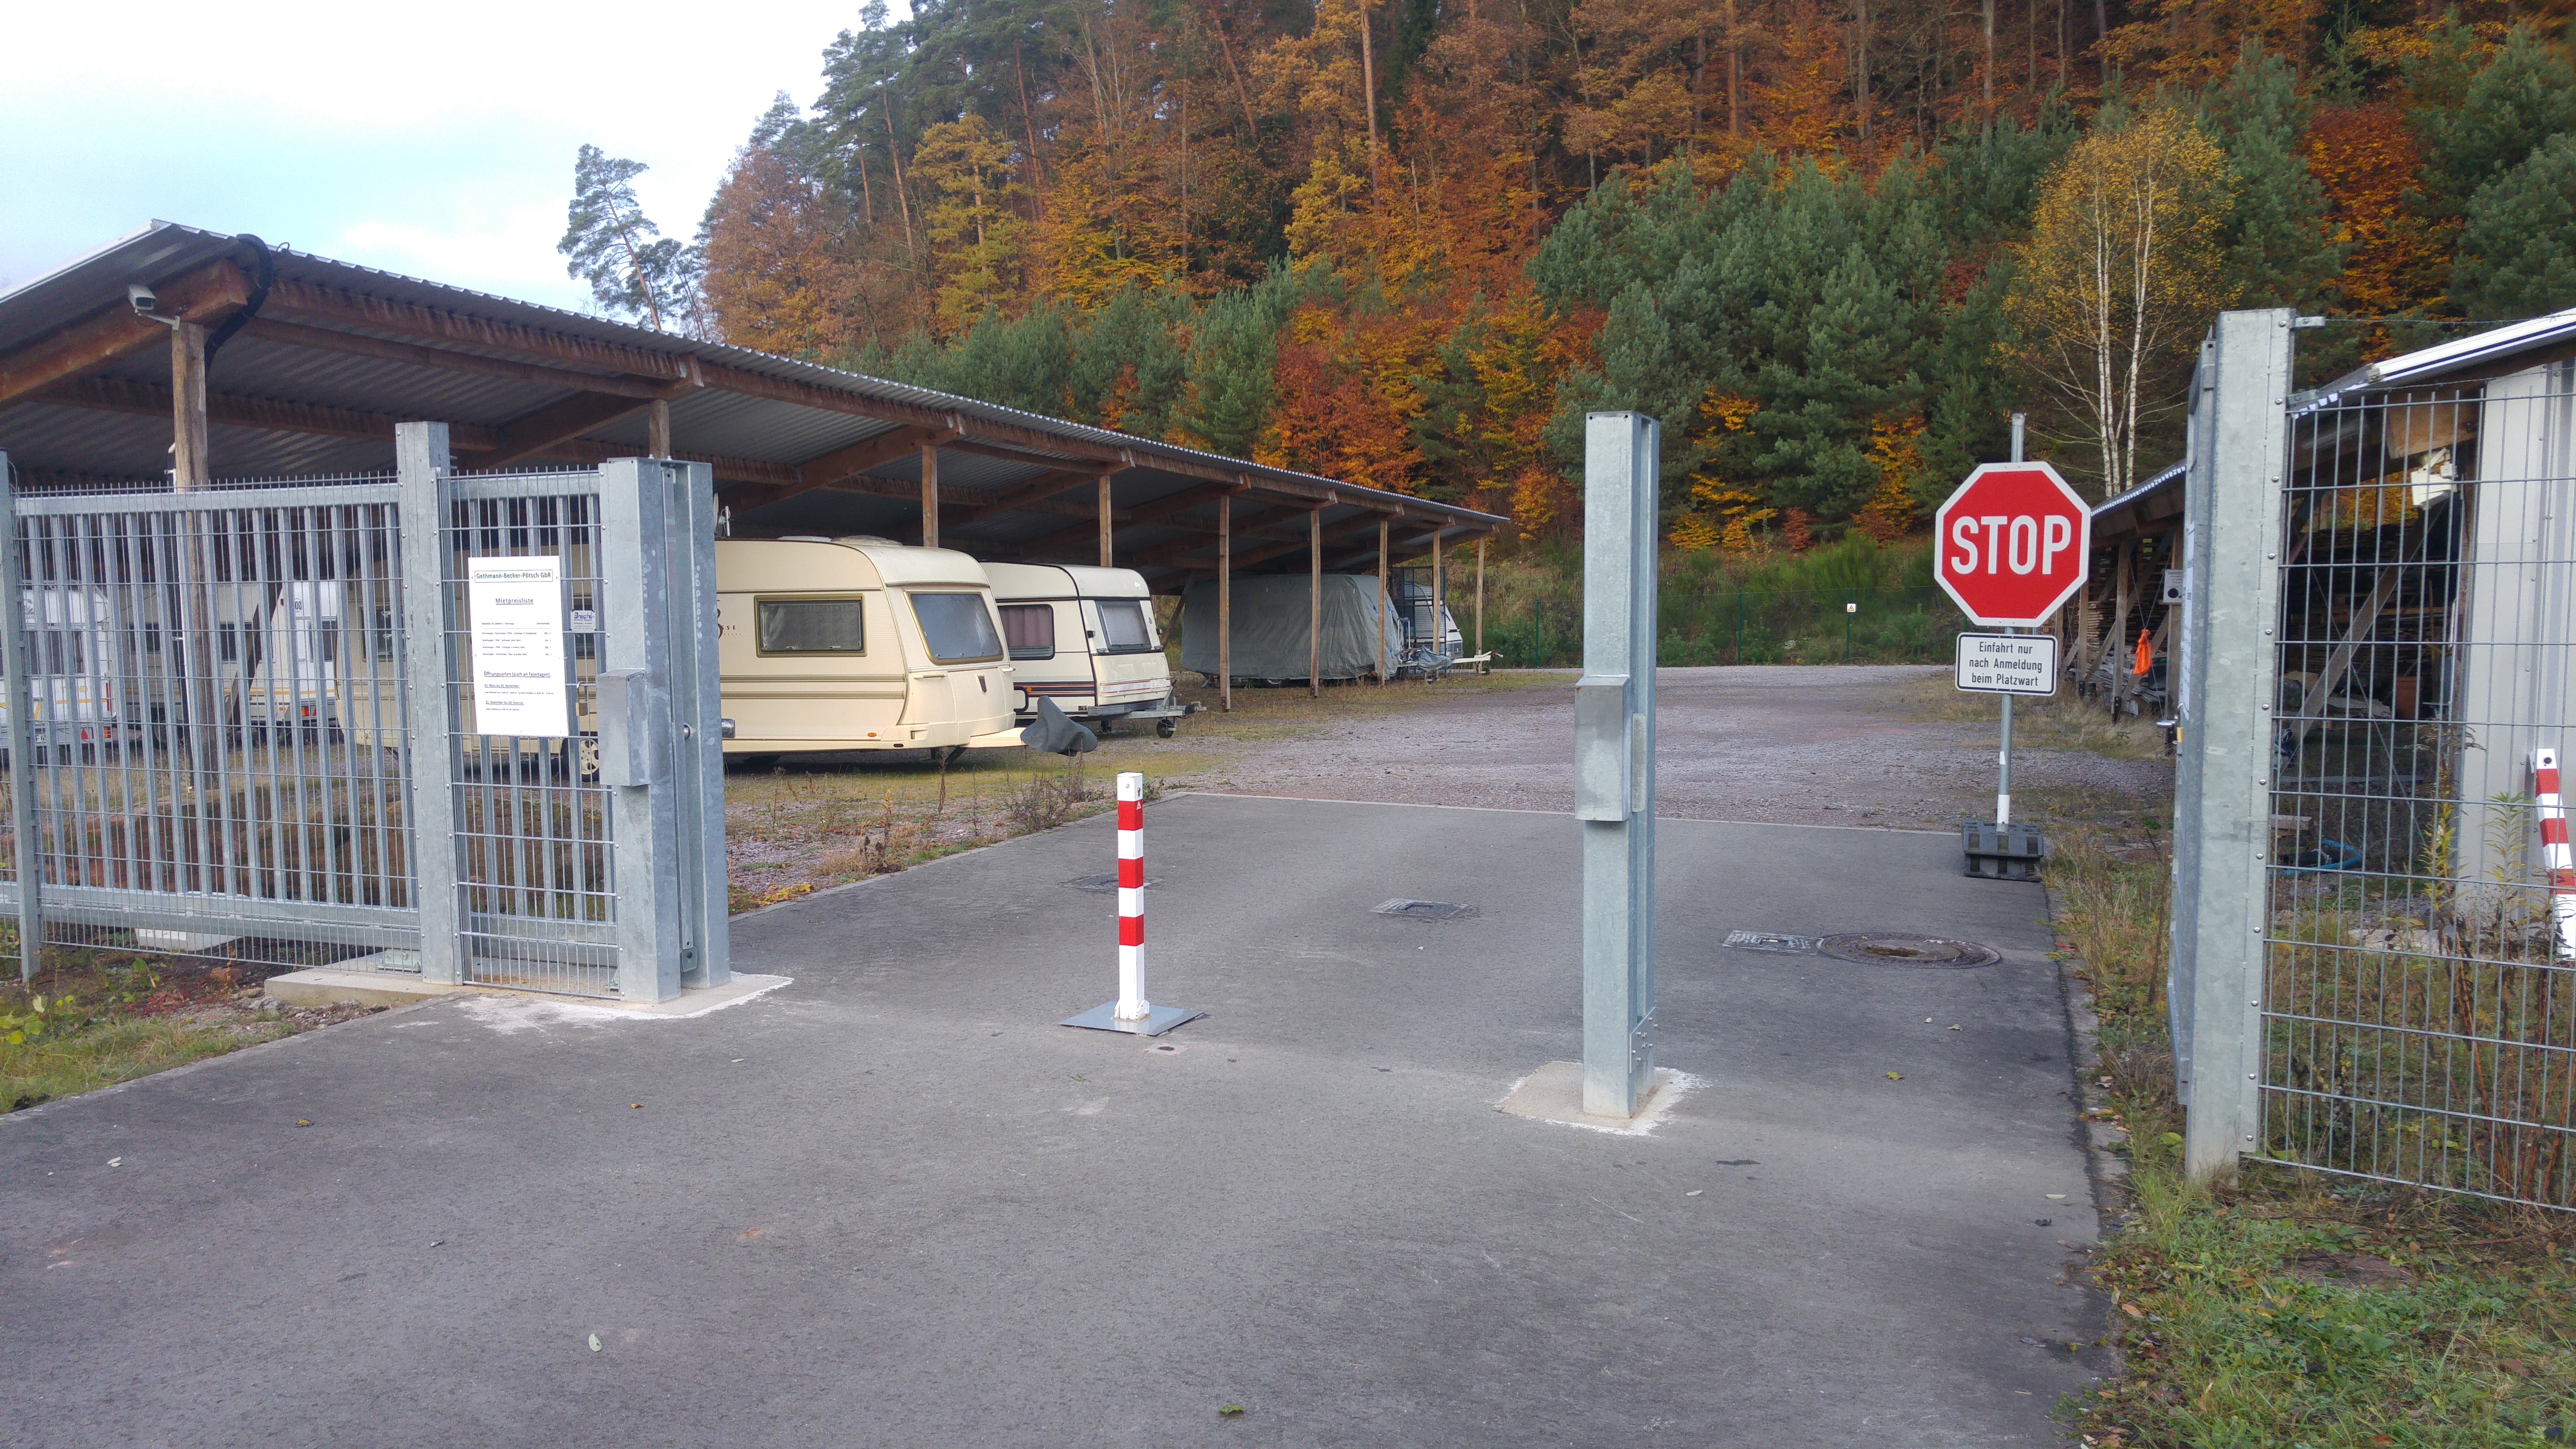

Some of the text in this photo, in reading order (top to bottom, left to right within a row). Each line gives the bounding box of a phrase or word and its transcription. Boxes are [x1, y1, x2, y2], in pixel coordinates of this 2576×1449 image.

[1951, 515, 2071, 575] STOP
[1979, 642, 2033, 654] Einfahrt nur
[1969, 658, 2042, 674] nach Anmeldung
[1972, 673, 2038, 687] beim Platzwart
